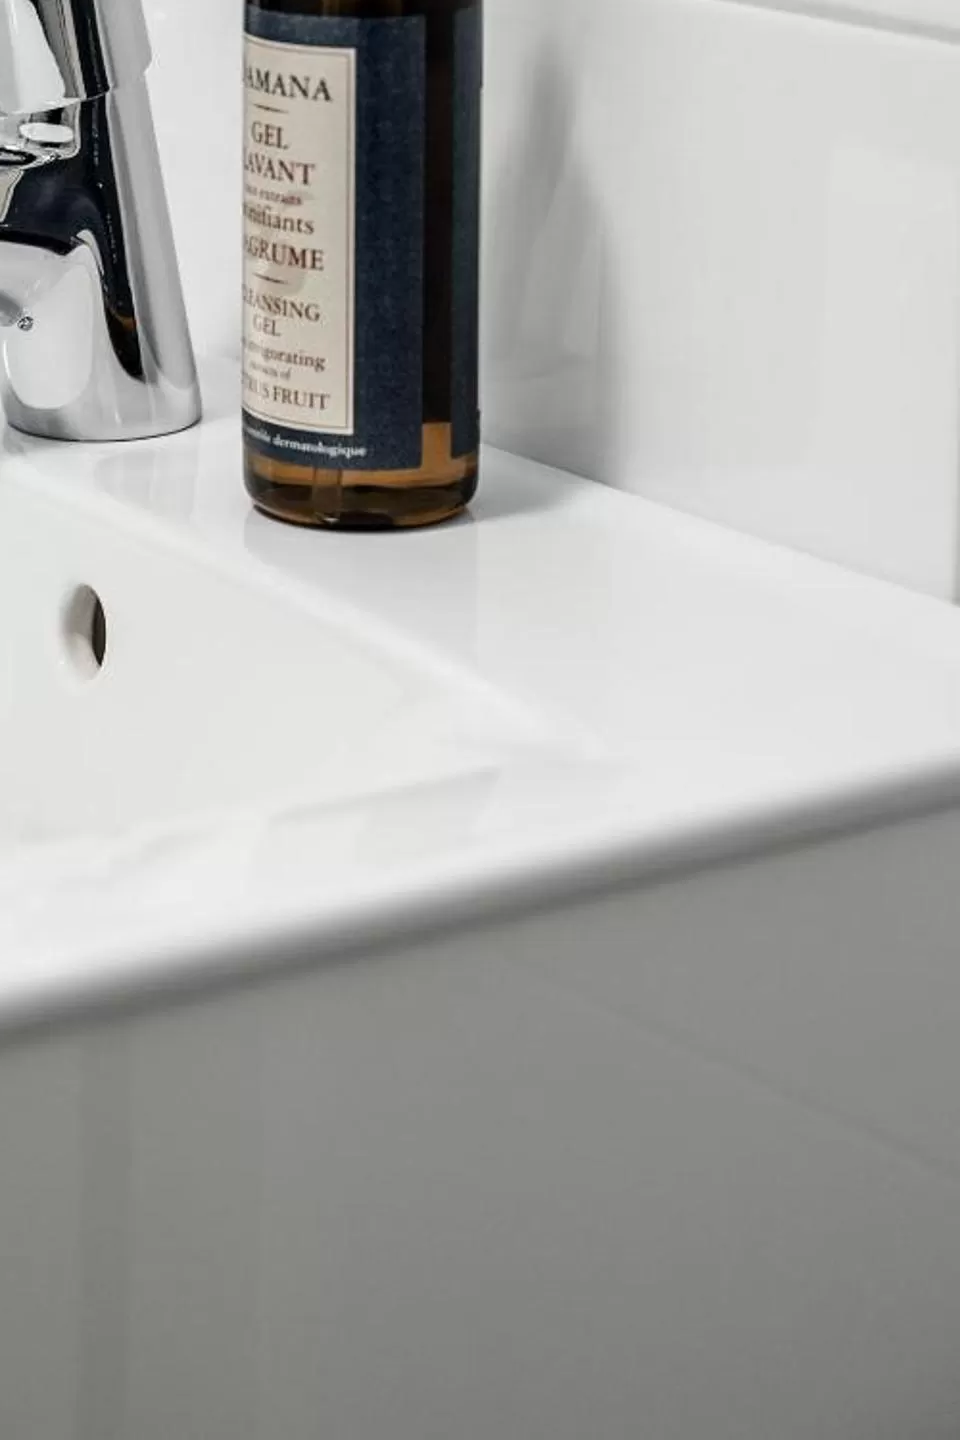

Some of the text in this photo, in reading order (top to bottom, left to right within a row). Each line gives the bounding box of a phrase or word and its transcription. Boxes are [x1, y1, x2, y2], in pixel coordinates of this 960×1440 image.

[251, 120, 290, 150] GEL
[244, 152, 316, 186] AVANT
[252, 312, 282, 337] GEL
[272, 385, 331, 411] FRUIT
